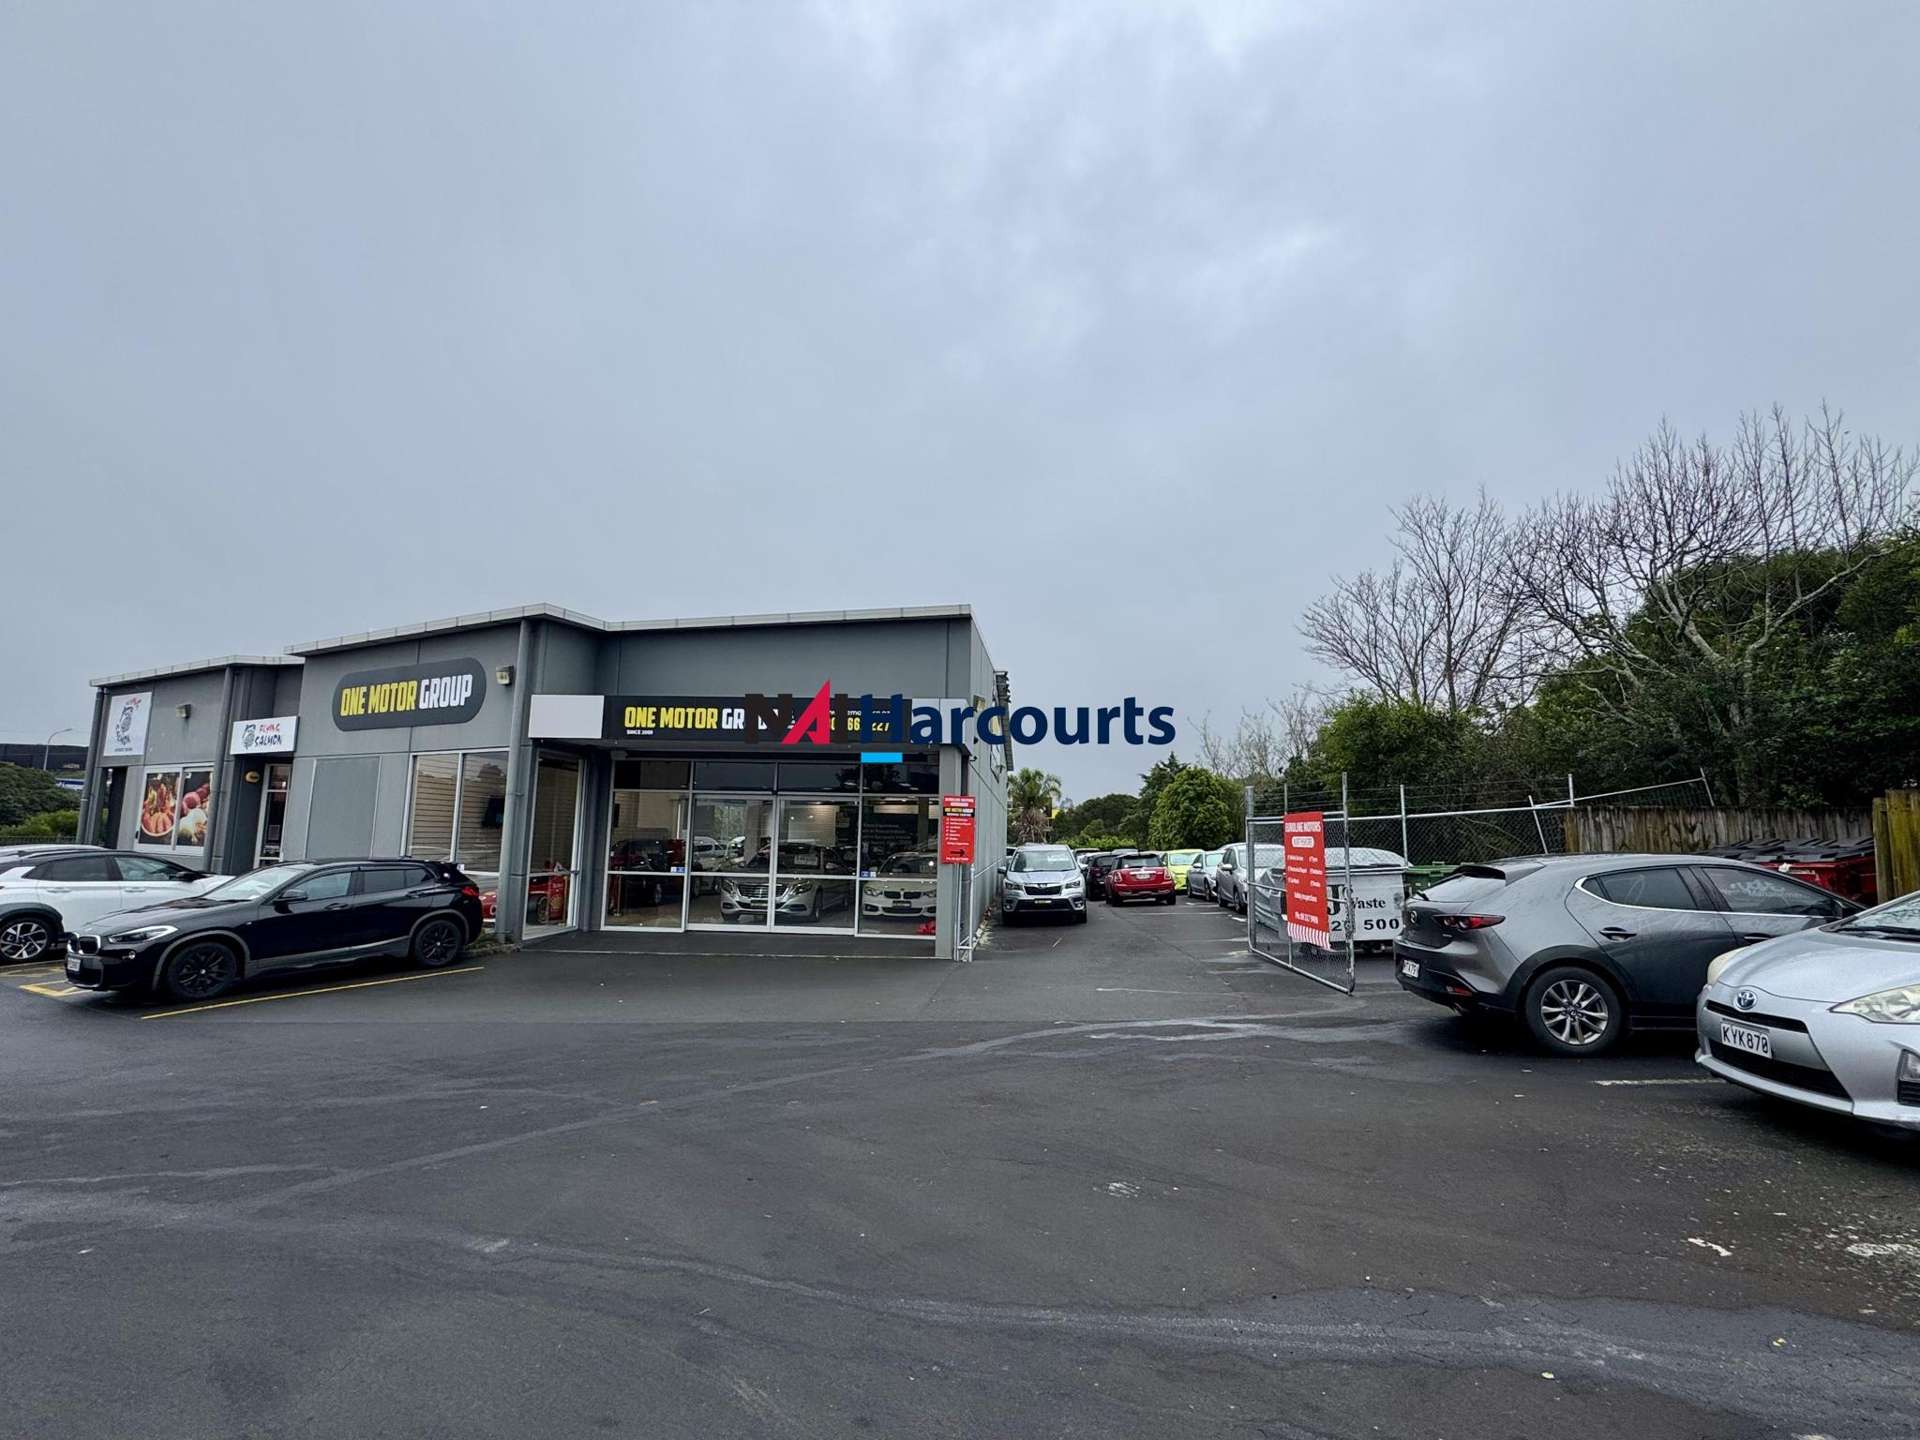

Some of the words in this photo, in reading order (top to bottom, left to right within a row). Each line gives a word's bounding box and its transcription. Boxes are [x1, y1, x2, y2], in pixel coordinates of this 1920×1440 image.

[340, 686, 367, 717] ONE
[367, 680, 418, 714] MOTOR
[418, 674, 473, 710] GROUP
[624, 706, 657, 728] ONE
[659, 707, 718, 729] MOTOR
[1364, 918, 1399, 931] 500
[1722, 1026, 1769, 1054] KYK870
